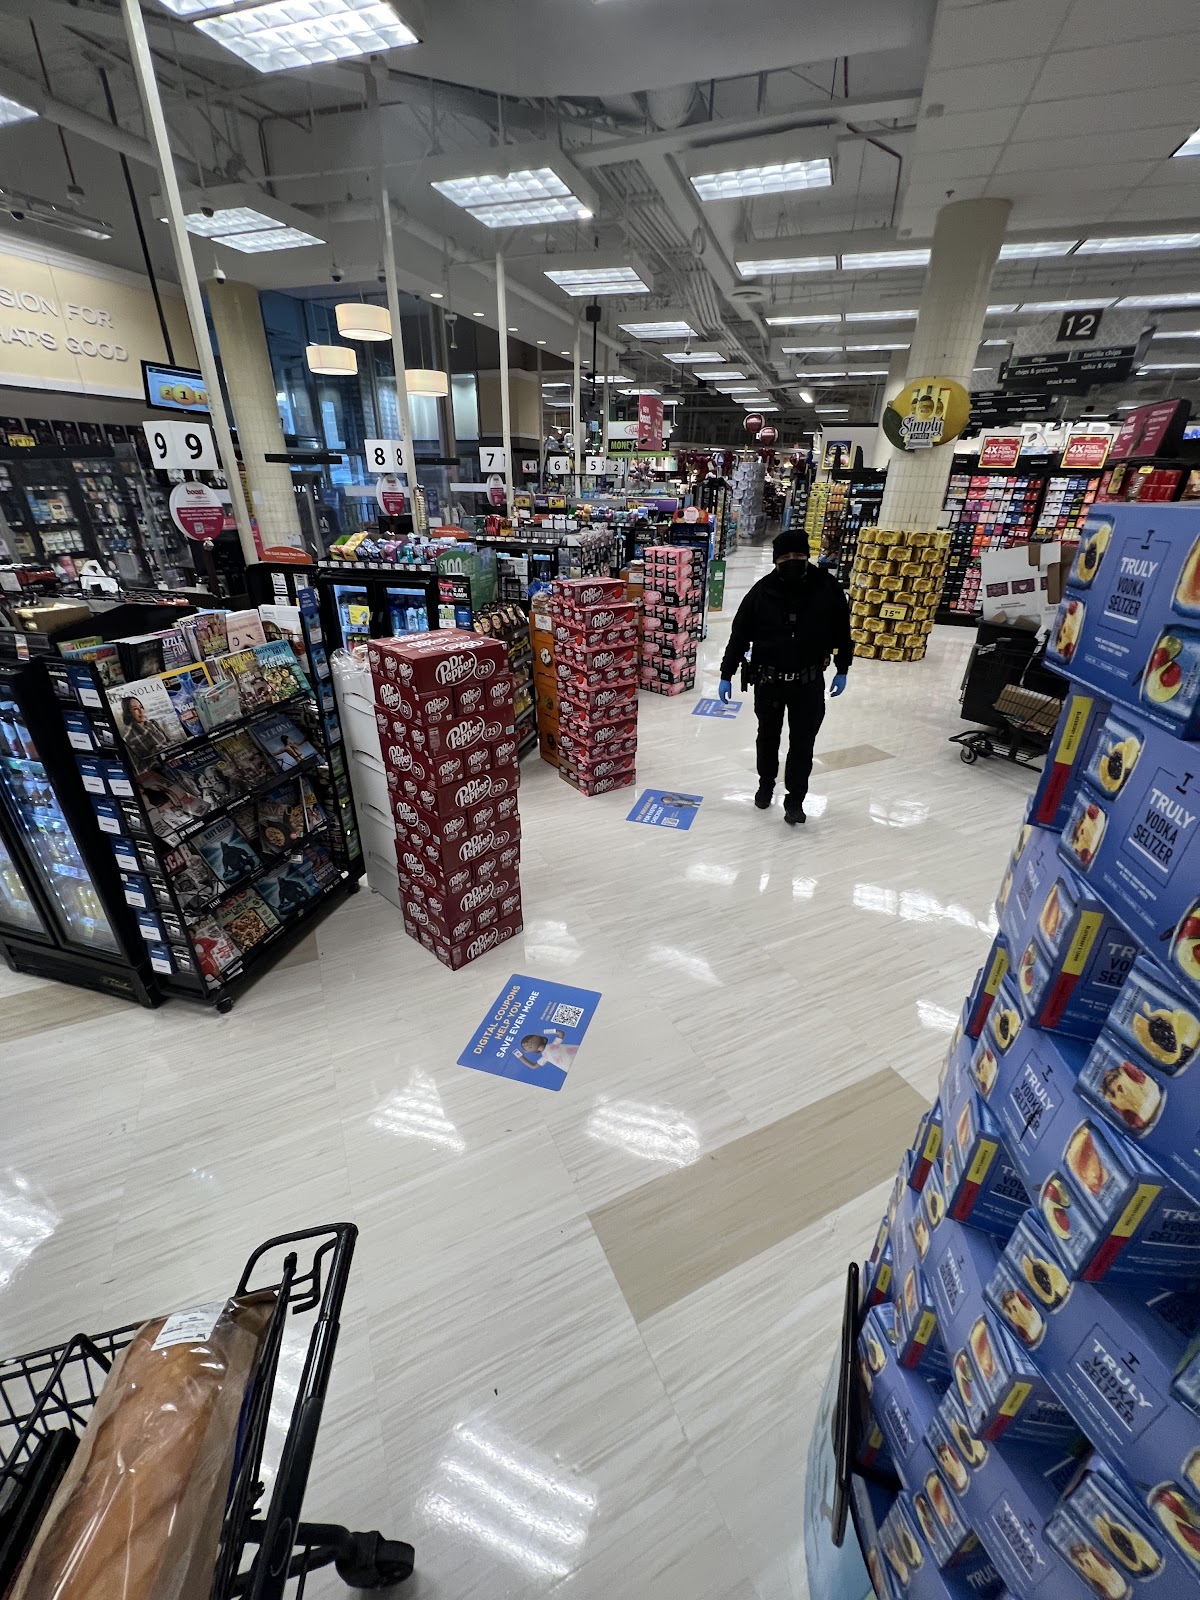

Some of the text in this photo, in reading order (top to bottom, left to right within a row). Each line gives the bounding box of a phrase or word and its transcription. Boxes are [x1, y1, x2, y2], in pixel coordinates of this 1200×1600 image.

[65, 302, 114, 329] FOR
[1064, 314, 1096, 338] 12
[65, 336, 129, 362] GOOD
[1105, 349, 1122, 357] chips
[1036, 366, 1058, 375] pretzels
[1103, 361, 1117, 369] dips
[180, 391, 189, 400] 1
[900, 417, 942, 436] Simply
[154, 432, 167, 459] 9
[185, 433, 203, 459] 9
[374, 447, 385, 466] 8
[985, 446, 998, 454] 4X
[1069, 445, 1086, 453] 4X
[396, 448, 403, 466] 8
[486, 453, 494, 467] 7
[554, 460, 561, 471] 6
[590, 460, 596, 471] 5
[613, 464, 619, 472] 2
[1120, 556, 1159, 578] TRULY
[1117, 577, 1143, 598] VODKA
[1108, 596, 1141, 618] SELTZER
[437, 656, 475, 686] Pepper
[449, 654, 464, 667] Dr
[108, 683, 163, 705] MAGNOLIA
[448, 724, 482, 750] Pepper
[460, 720, 473, 732] Dr
[456, 780, 489, 807] Pepper
[467, 778, 481, 790] Dr
[1151, 788, 1196, 830] TRULY
[1145, 809, 1179, 845] VODKA
[460, 836, 492, 861] Pepper
[469, 833, 484, 845] Dr
[1133, 824, 1173, 865] SELTZER
[462, 886, 491, 912] Pepper
[471, 884, 483, 896] Dr
[467, 934, 495, 960] Pepper
[477, 931, 488, 942] Dr
[473, 985, 521, 1054] DIGITAL COUPONS
[494, 1001, 522, 1040] HELP YOU
[496, 990, 539, 1058] SAVE EVEN MORE
[1024, 1064, 1054, 1111] TRULY
[1093, 1338, 1153, 1408] TRULY
[1093, 1356, 1136, 1412] VODKA
[1082, 1360, 1135, 1425] SELTZER
